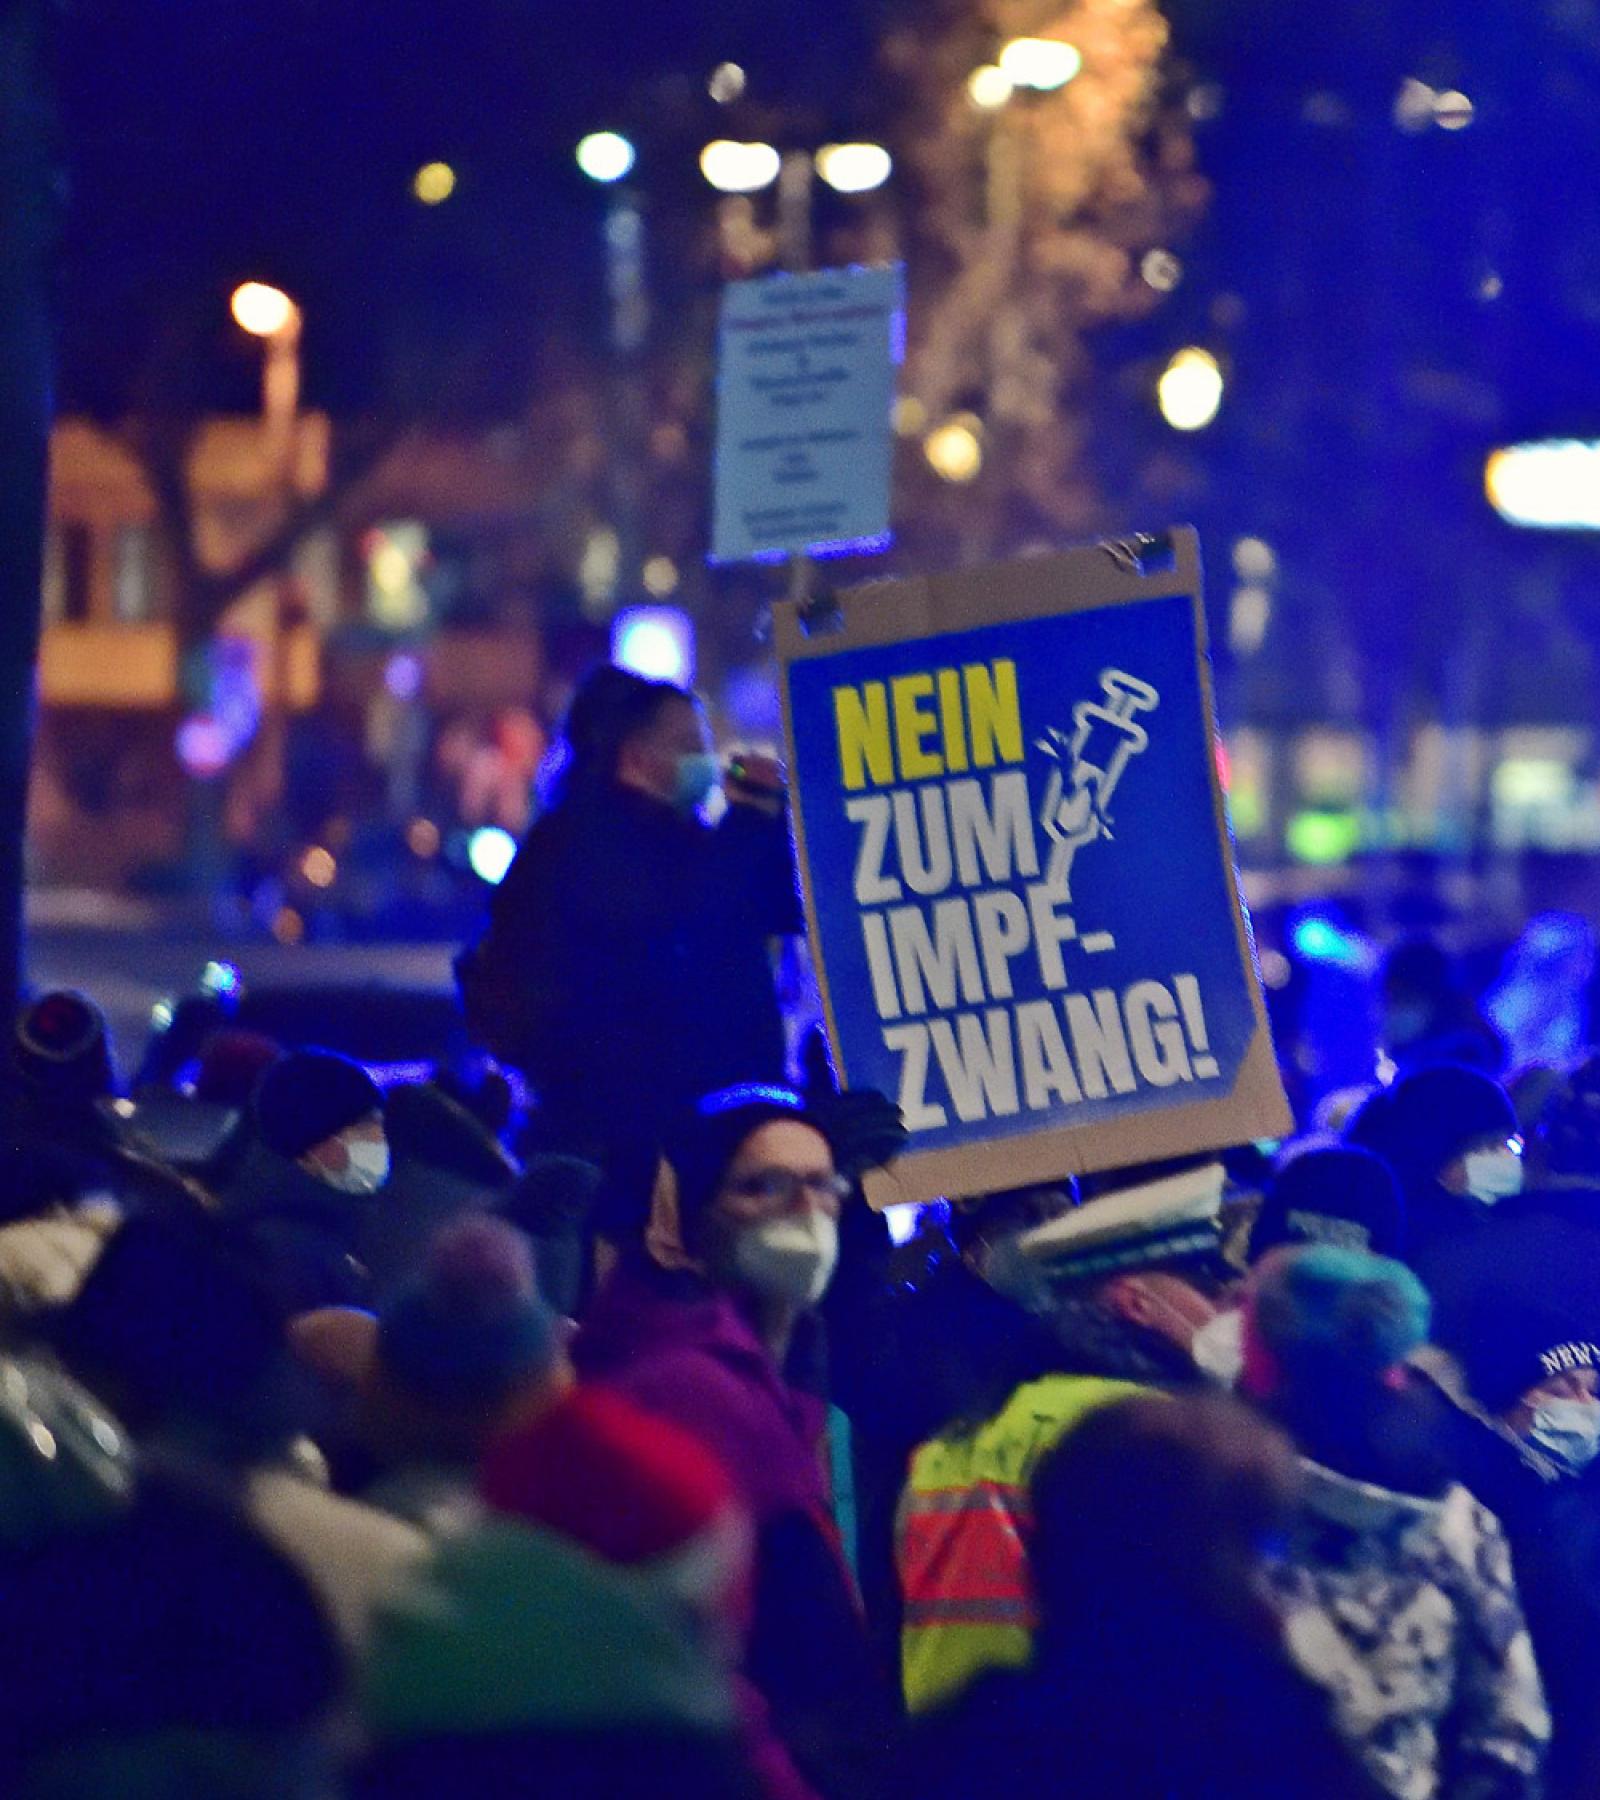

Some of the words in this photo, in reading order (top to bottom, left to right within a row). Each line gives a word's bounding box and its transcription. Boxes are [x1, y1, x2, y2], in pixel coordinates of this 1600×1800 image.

[833, 658, 1024, 790] NEIN
[846, 772, 1040, 905] ZUM
[861, 883, 1116, 1020] IMPF-
[883, 974, 1219, 1131] ZWANG!
